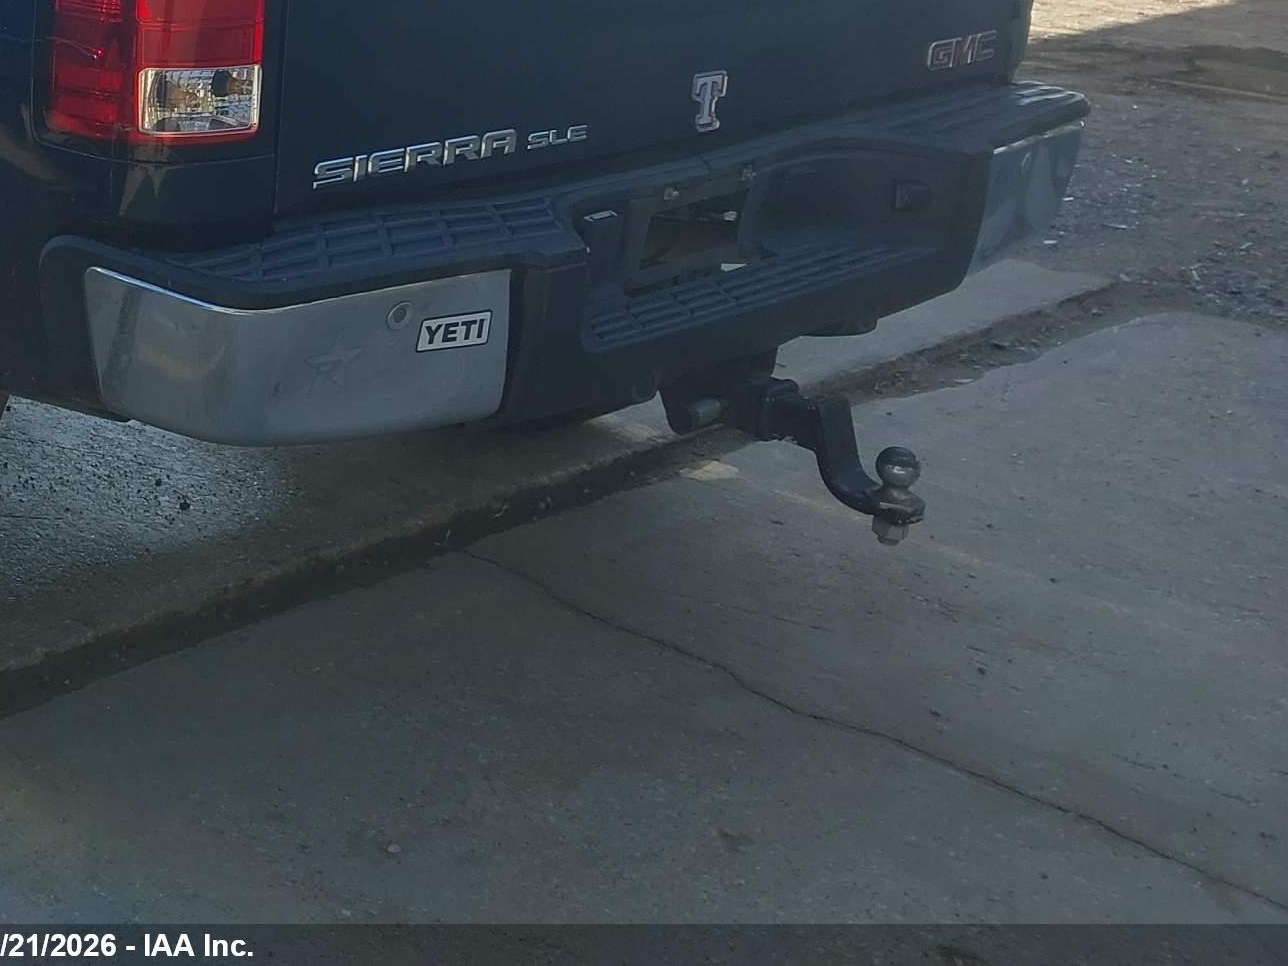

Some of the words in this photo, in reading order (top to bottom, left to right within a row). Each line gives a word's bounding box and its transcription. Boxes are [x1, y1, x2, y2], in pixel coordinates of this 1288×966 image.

[928, 31, 998, 71] GMC
[691, 70, 728, 132] T
[312, 128, 518, 188] SIERRA
[526, 123, 589, 150] SLE
[425, 318, 488, 345] YETI
